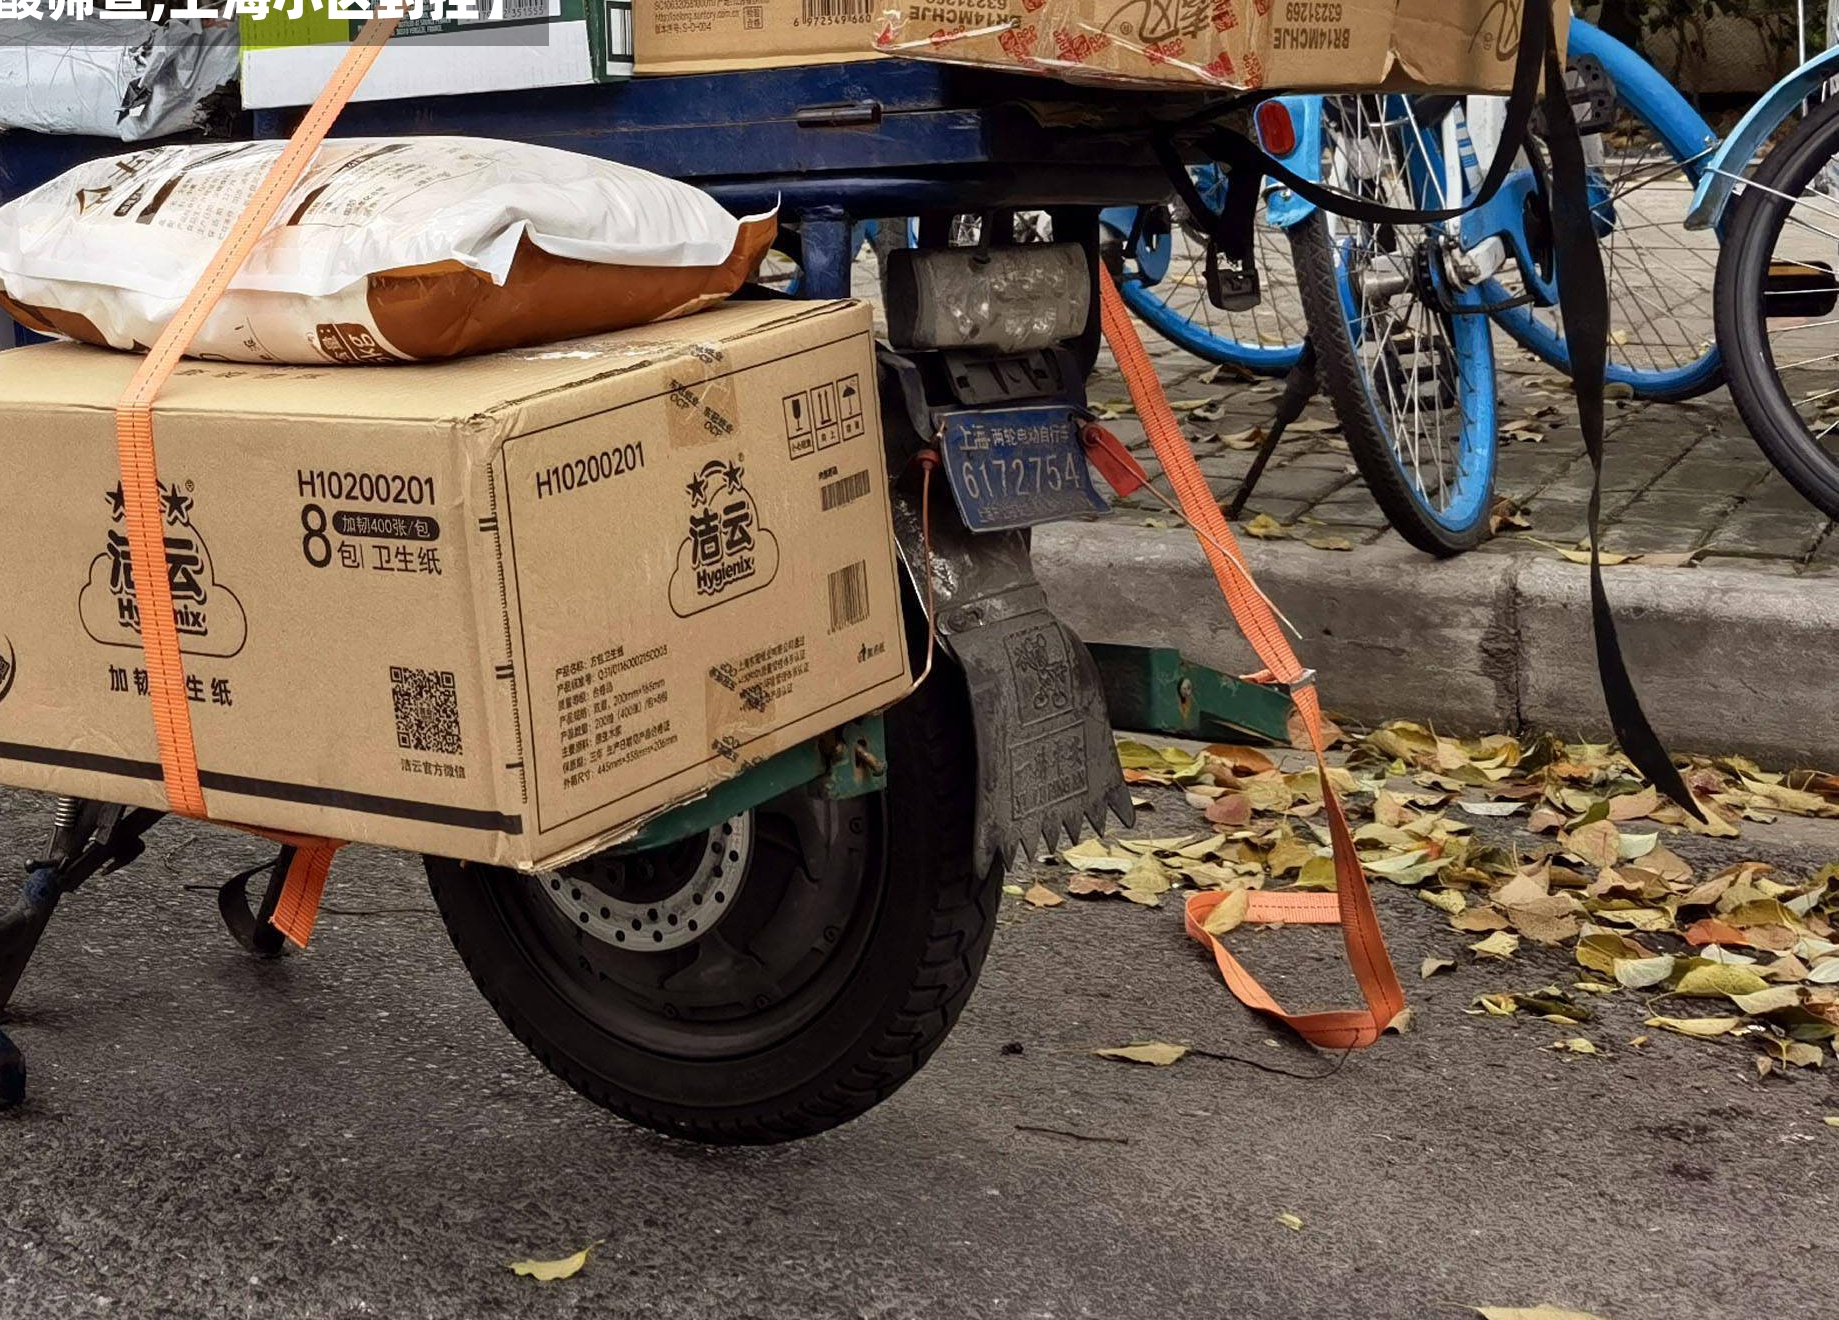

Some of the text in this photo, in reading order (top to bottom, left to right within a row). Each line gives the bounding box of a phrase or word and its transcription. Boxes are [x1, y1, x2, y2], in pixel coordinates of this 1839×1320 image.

[1284, 1, 1343, 23] 63231269
[1272, 25, 1350, 51] BR14MCHJE
[704, 421, 723, 437] OCP
[296, 469, 436, 506] H10200201
[535, 441, 646, 499] H10200201
[962, 452, 1081, 499] 6172754
[301, 504, 432, 568] 8 加韧400张/包
[689, 499, 756, 568] 洁云
[372, 544, 443, 576] 卫生纸
[696, 558, 755, 596] Hygienix
[108, 665, 233, 706] 加韧生纸
[400, 756, 466, 780] 洁云官方微信
